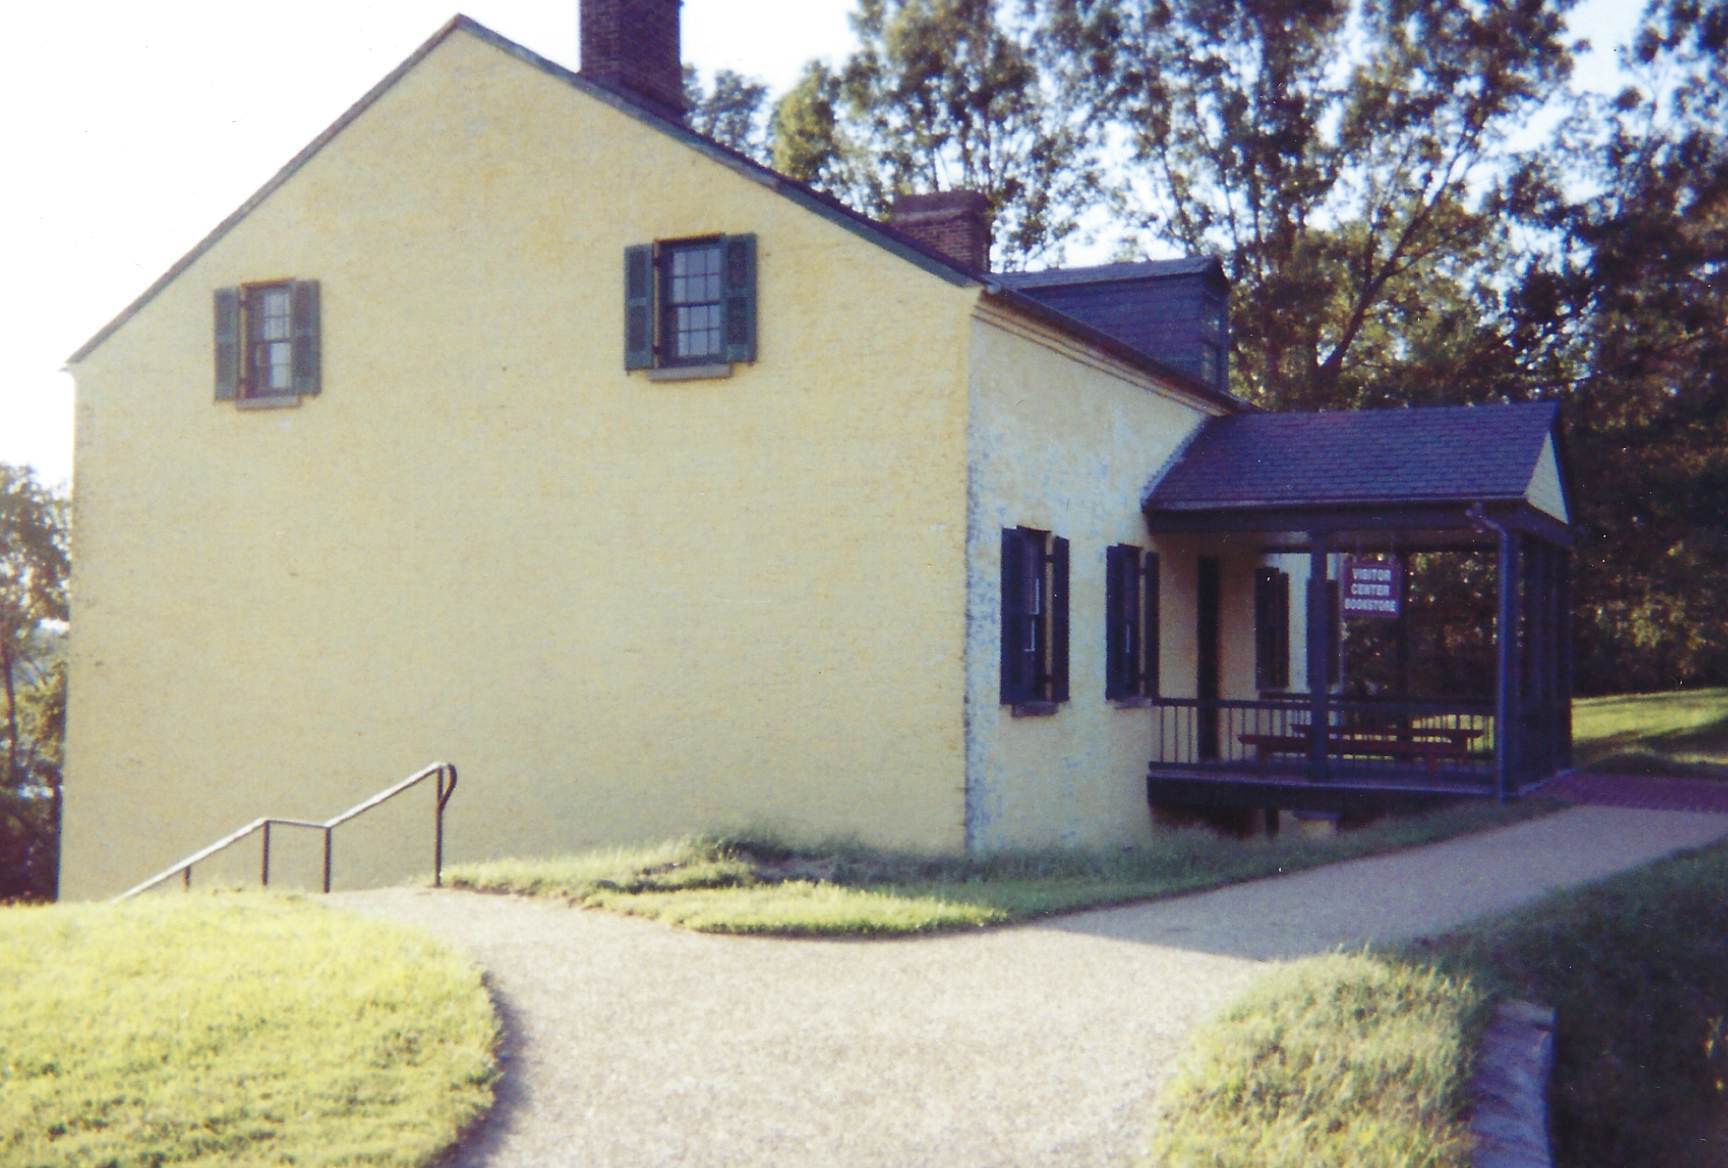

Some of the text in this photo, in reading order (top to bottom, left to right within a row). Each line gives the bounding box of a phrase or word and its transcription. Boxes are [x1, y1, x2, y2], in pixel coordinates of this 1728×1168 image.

[1352, 568, 1391, 581] VISITOR
[1351, 584, 1389, 596] CENTER
[1344, 598, 1396, 611] BOOKSTORE
